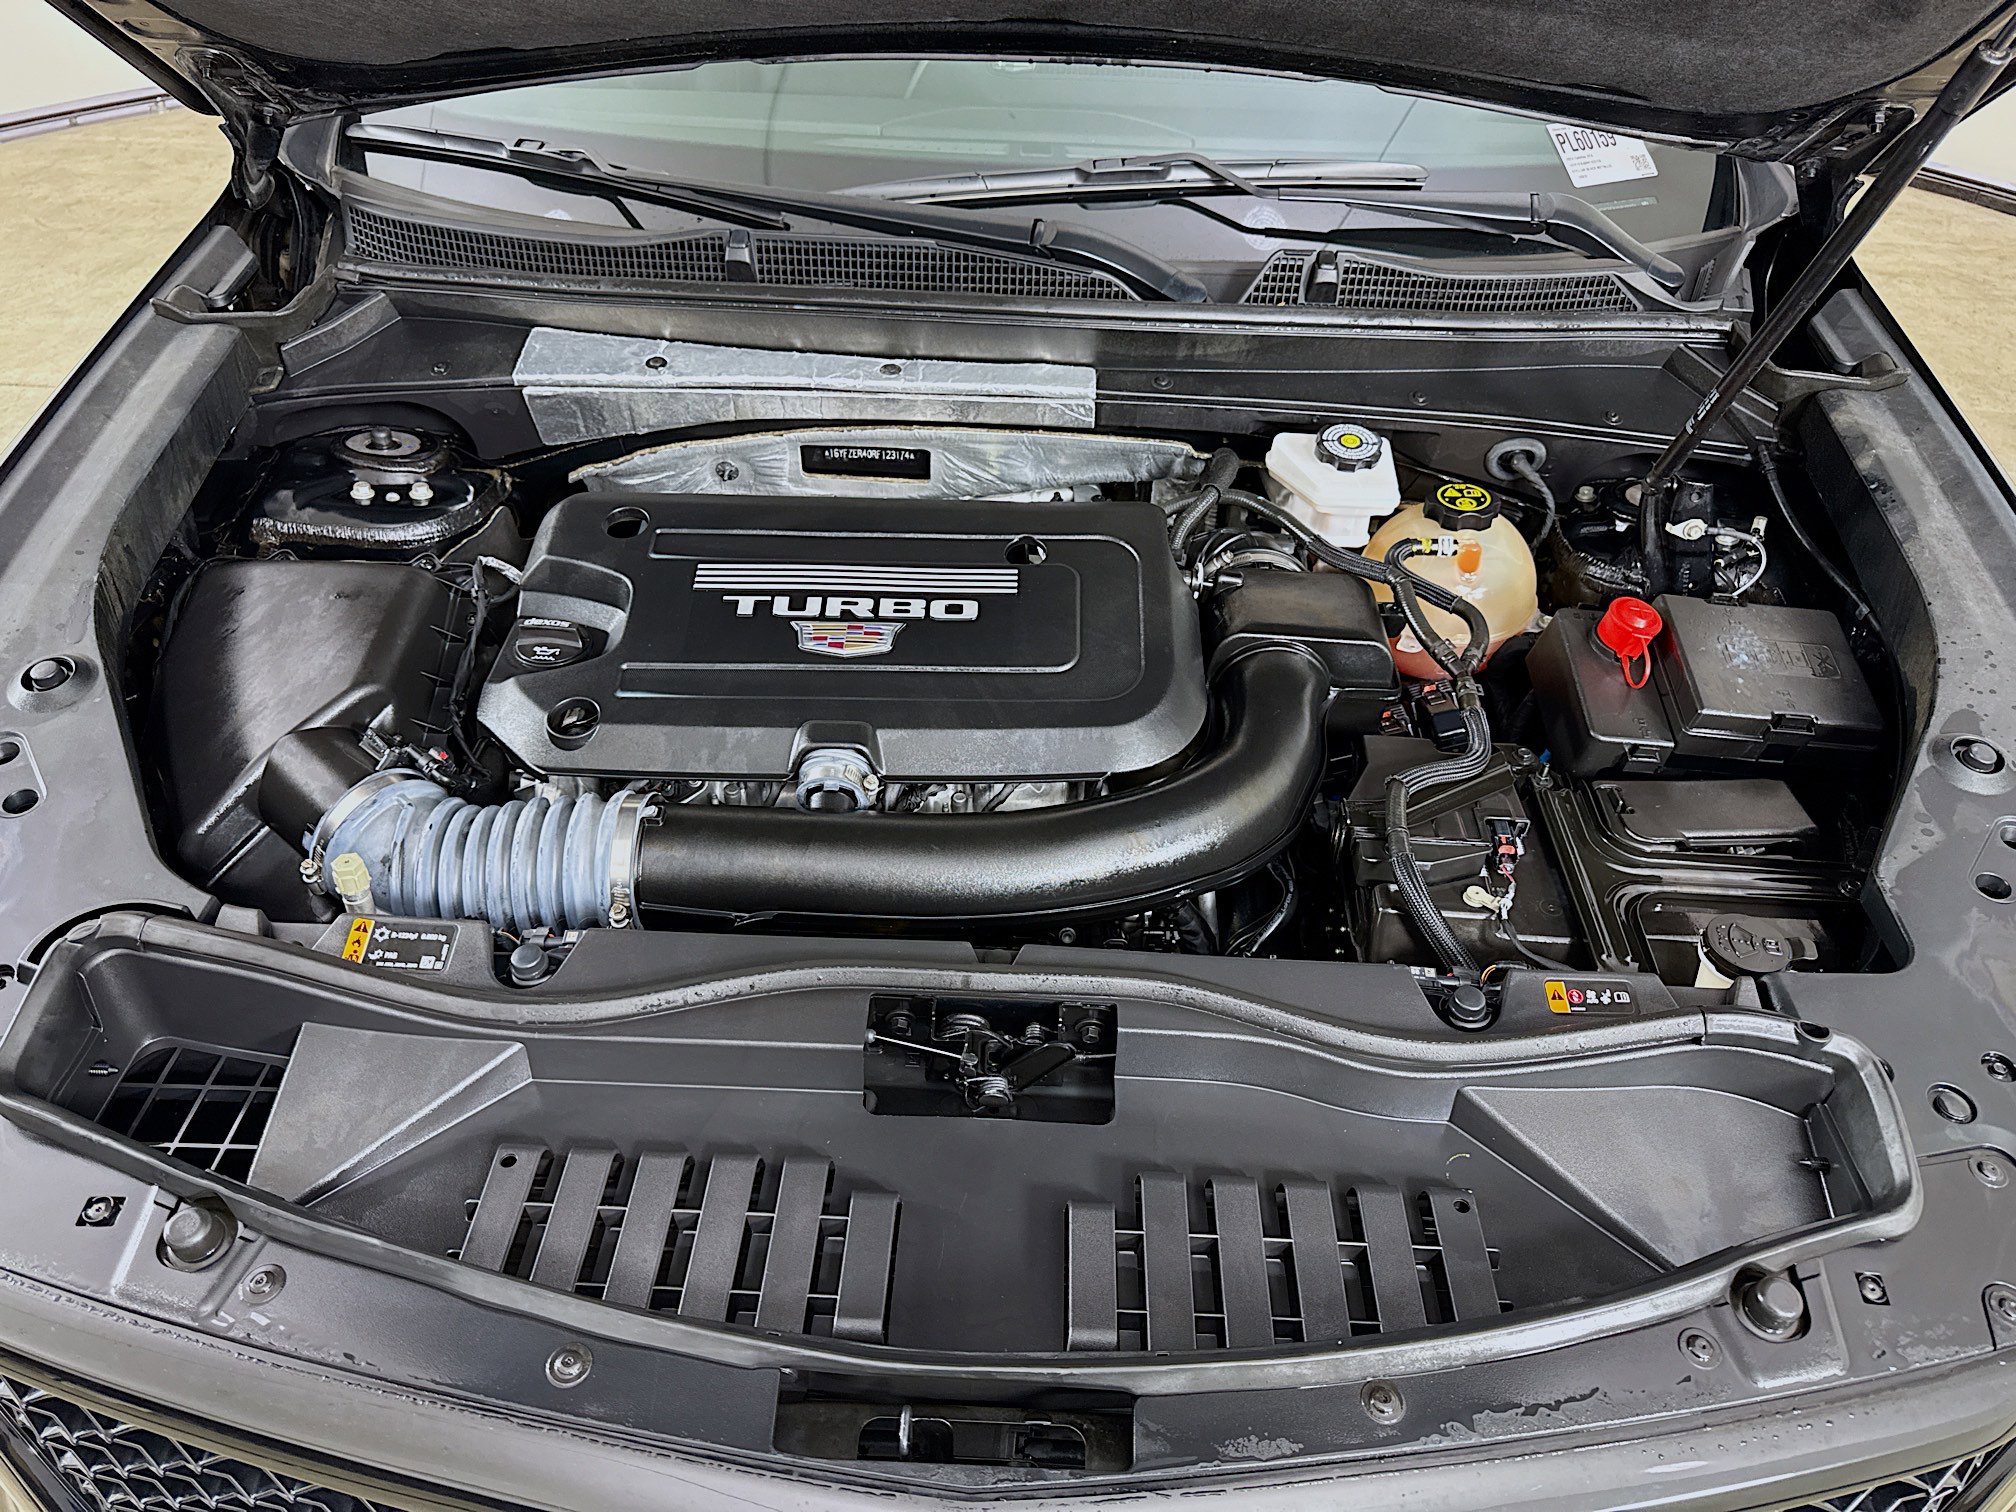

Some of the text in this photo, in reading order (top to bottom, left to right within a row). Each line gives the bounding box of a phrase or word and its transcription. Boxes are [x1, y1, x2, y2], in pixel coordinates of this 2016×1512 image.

[1555, 129, 1617, 154] PL60159
[722, 595, 979, 621] TURBO
[523, 617, 572, 628] dexos
